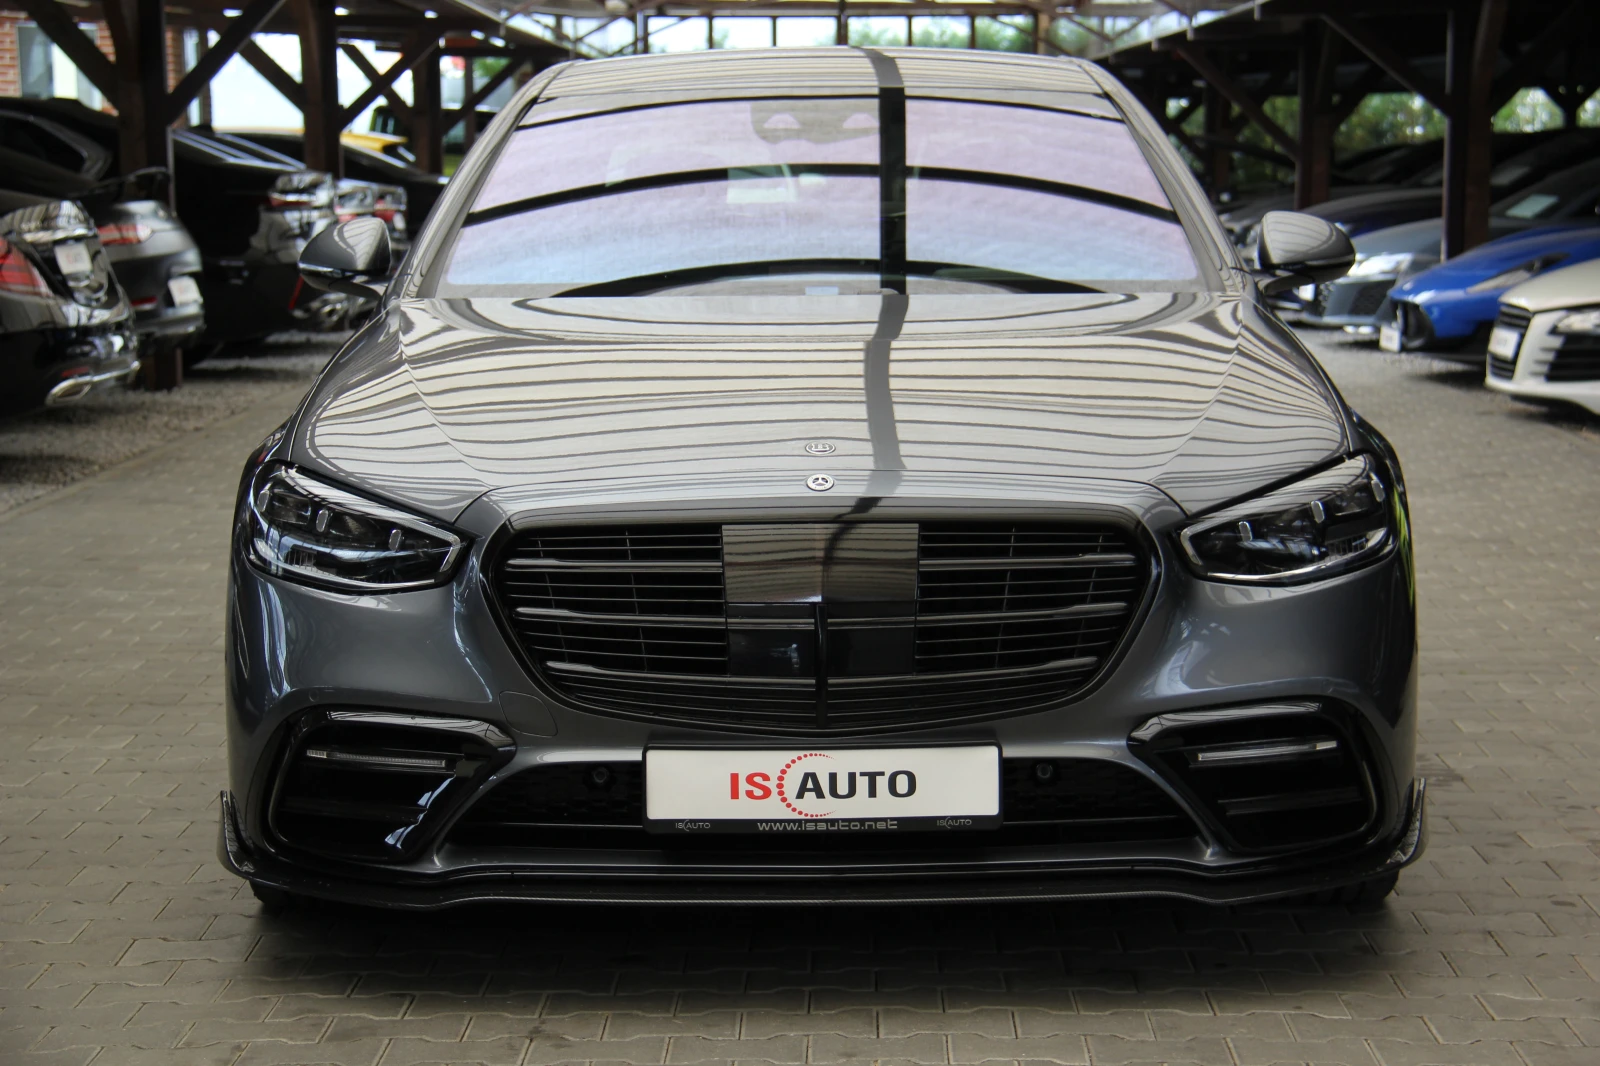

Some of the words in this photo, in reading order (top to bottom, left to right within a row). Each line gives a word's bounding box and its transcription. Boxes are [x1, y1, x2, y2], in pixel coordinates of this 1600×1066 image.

[729, 771, 773, 801] IS
[795, 770, 917, 800] AUTO
[757, 819, 898, 831] www.isauto.net
